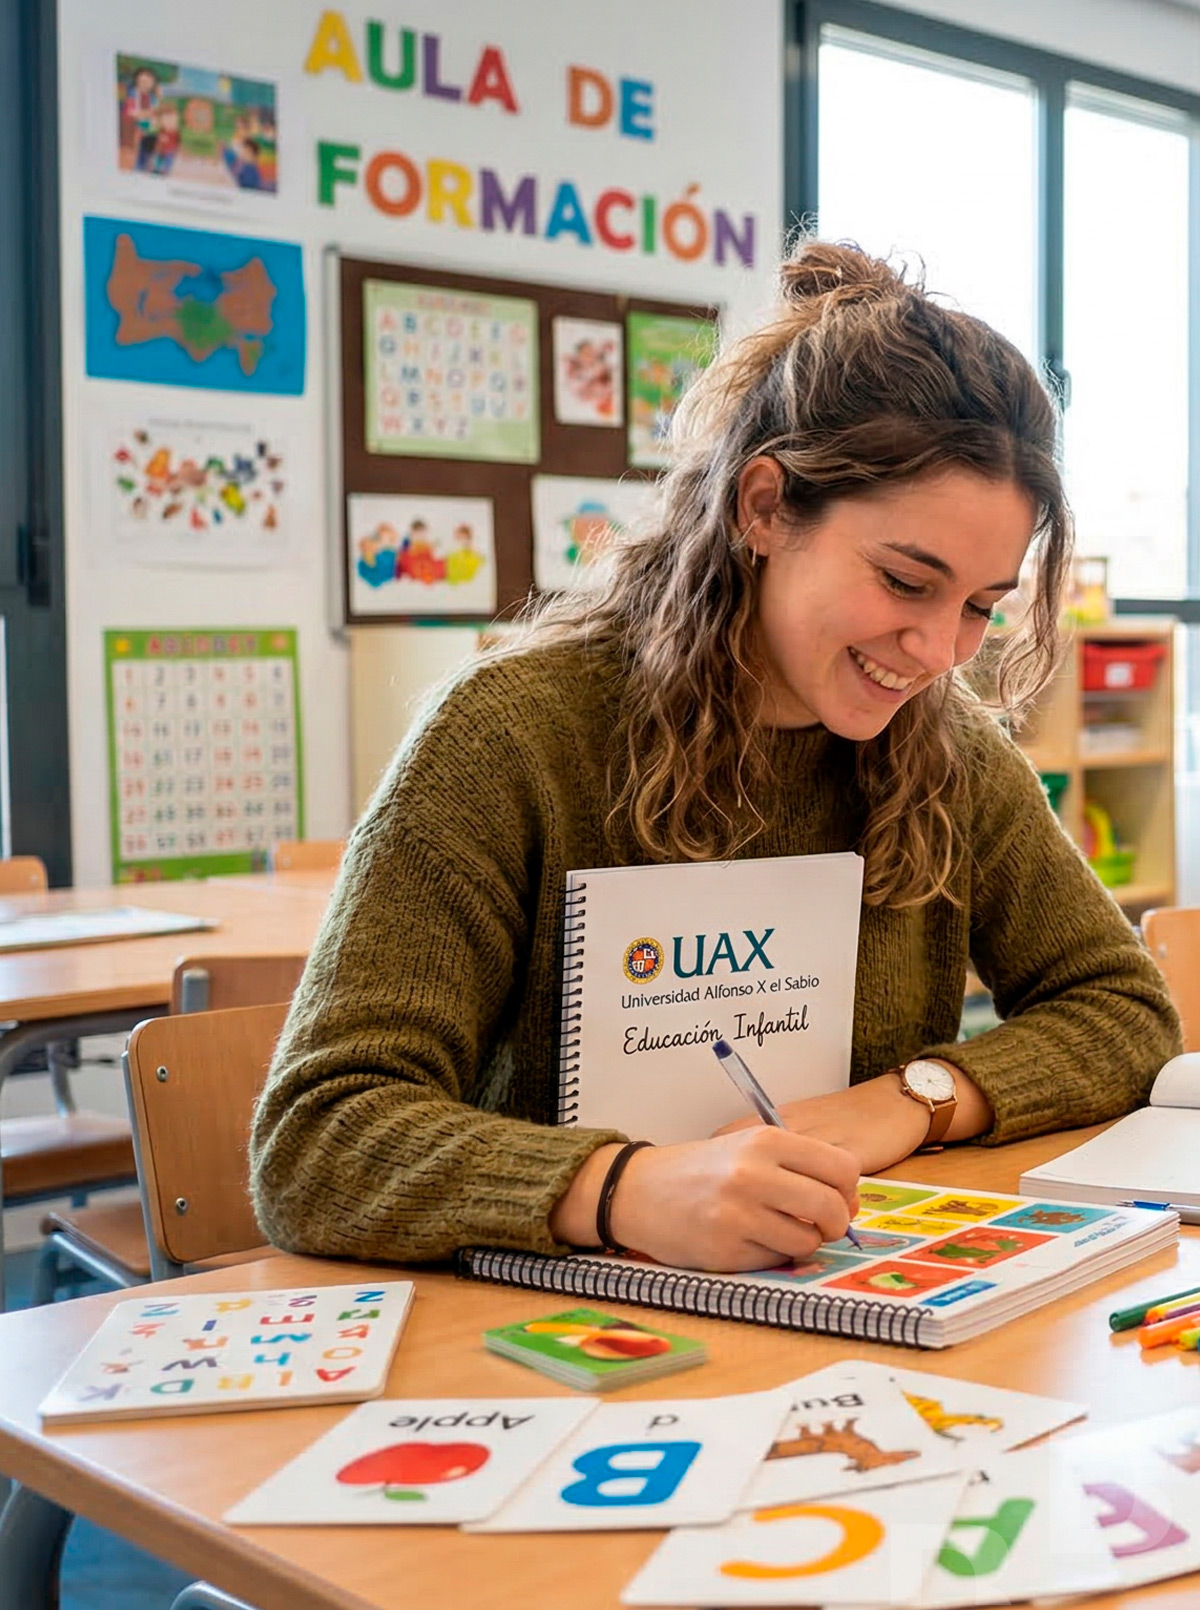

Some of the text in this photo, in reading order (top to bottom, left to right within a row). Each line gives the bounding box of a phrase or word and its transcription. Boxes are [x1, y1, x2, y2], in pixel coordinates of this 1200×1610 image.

[304, 9, 655, 143] AULA DE
[314, 139, 757, 269] FORMACIÓN
[672, 928, 775, 979] UAX
[621, 975, 820, 1010] Universidad Alfonso X el Sabio
[623, 1004, 809, 1055] Educación Infantil
[388, 1411, 535, 1432] Apple
[560, 1440, 702, 1507] B
[718, 1504, 886, 1579] C
